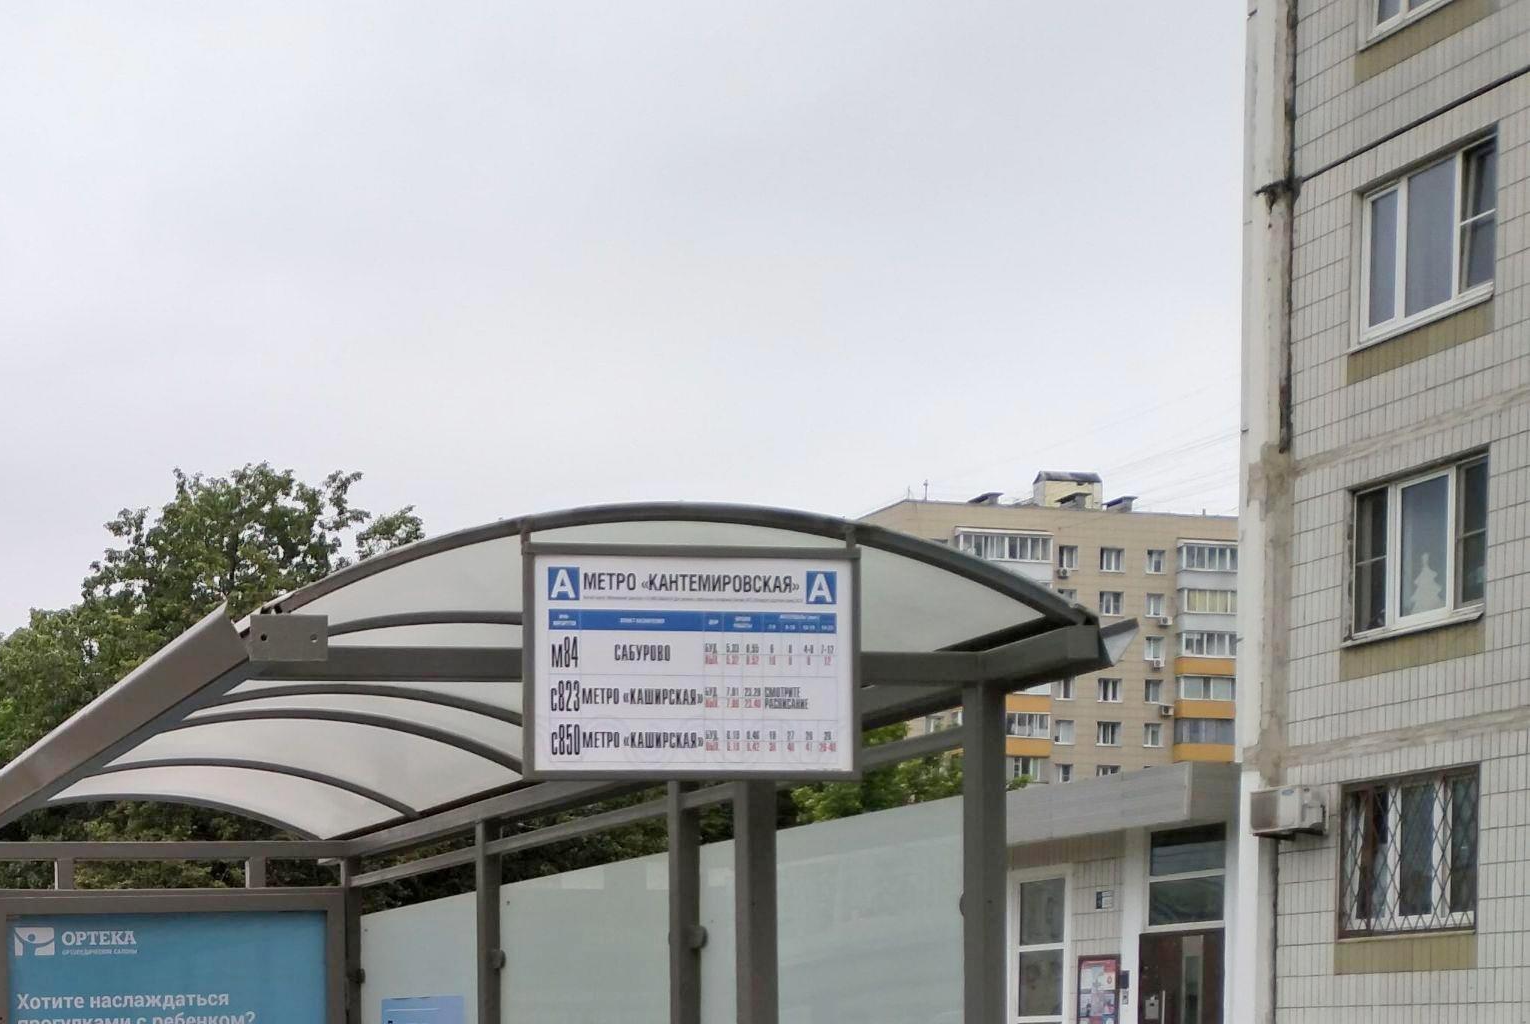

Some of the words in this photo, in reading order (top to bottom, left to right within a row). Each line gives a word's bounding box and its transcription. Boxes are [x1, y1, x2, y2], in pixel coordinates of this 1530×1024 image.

[551, 569, 576, 598] А
[583, 572, 637, 591] МЕТРО
[641, 573, 800, 593] «КАНТЕМИРОВСКАЯ»
[808, 573, 832, 602] А
[614, 644, 671, 662] САБУРОВО
[582, 687, 620, 705] МЕТРО
[623, 688, 703, 706] «КАШИРСКАЯ»
[764, 687, 800, 697] СМОТРИТЕ
[764, 698, 809, 709] РАСПИСАНИЕ
[582, 731, 620, 748] МЕТРО
[623, 732, 703, 749] «КАШИРСКАЯ»
[61, 930, 137, 946] ОРТЕКА
[16, 993, 85, 1011] Хотите
[90, 992, 230, 1010] наслаждаться
